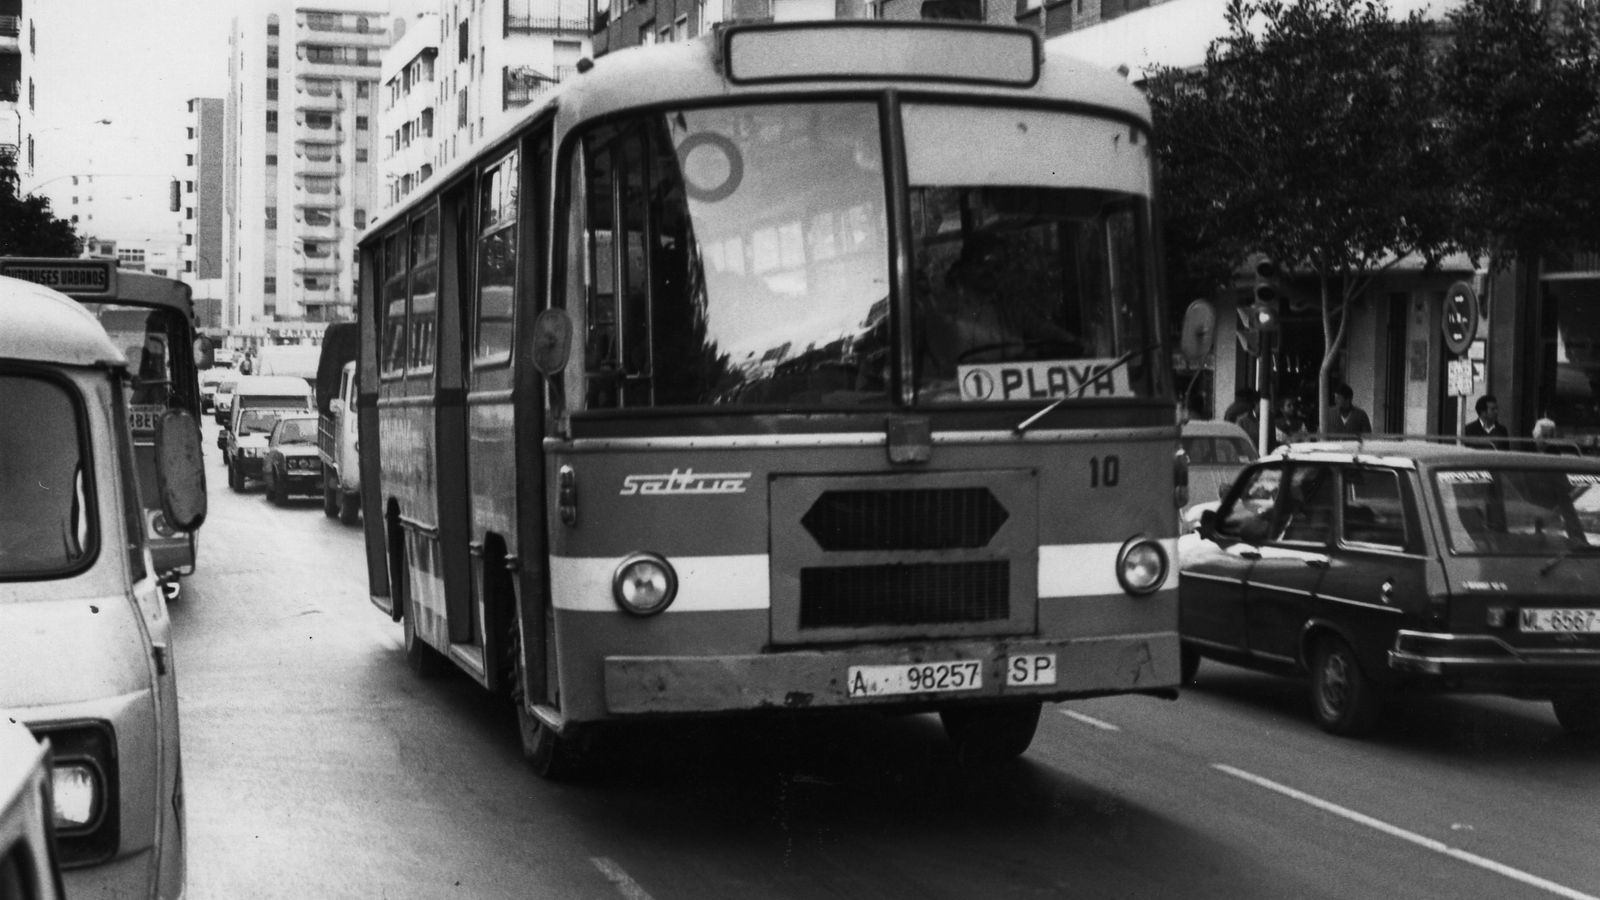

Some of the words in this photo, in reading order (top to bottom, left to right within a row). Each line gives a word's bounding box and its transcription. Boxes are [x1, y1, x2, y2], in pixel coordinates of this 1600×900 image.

[61, 270, 105, 286] URBANOS
[1001, 364, 1115, 399] PLAYA
[1089, 454, 1120, 488] 10
[907, 663, 979, 690] 98257
[1012, 656, 1051, 683] SP
